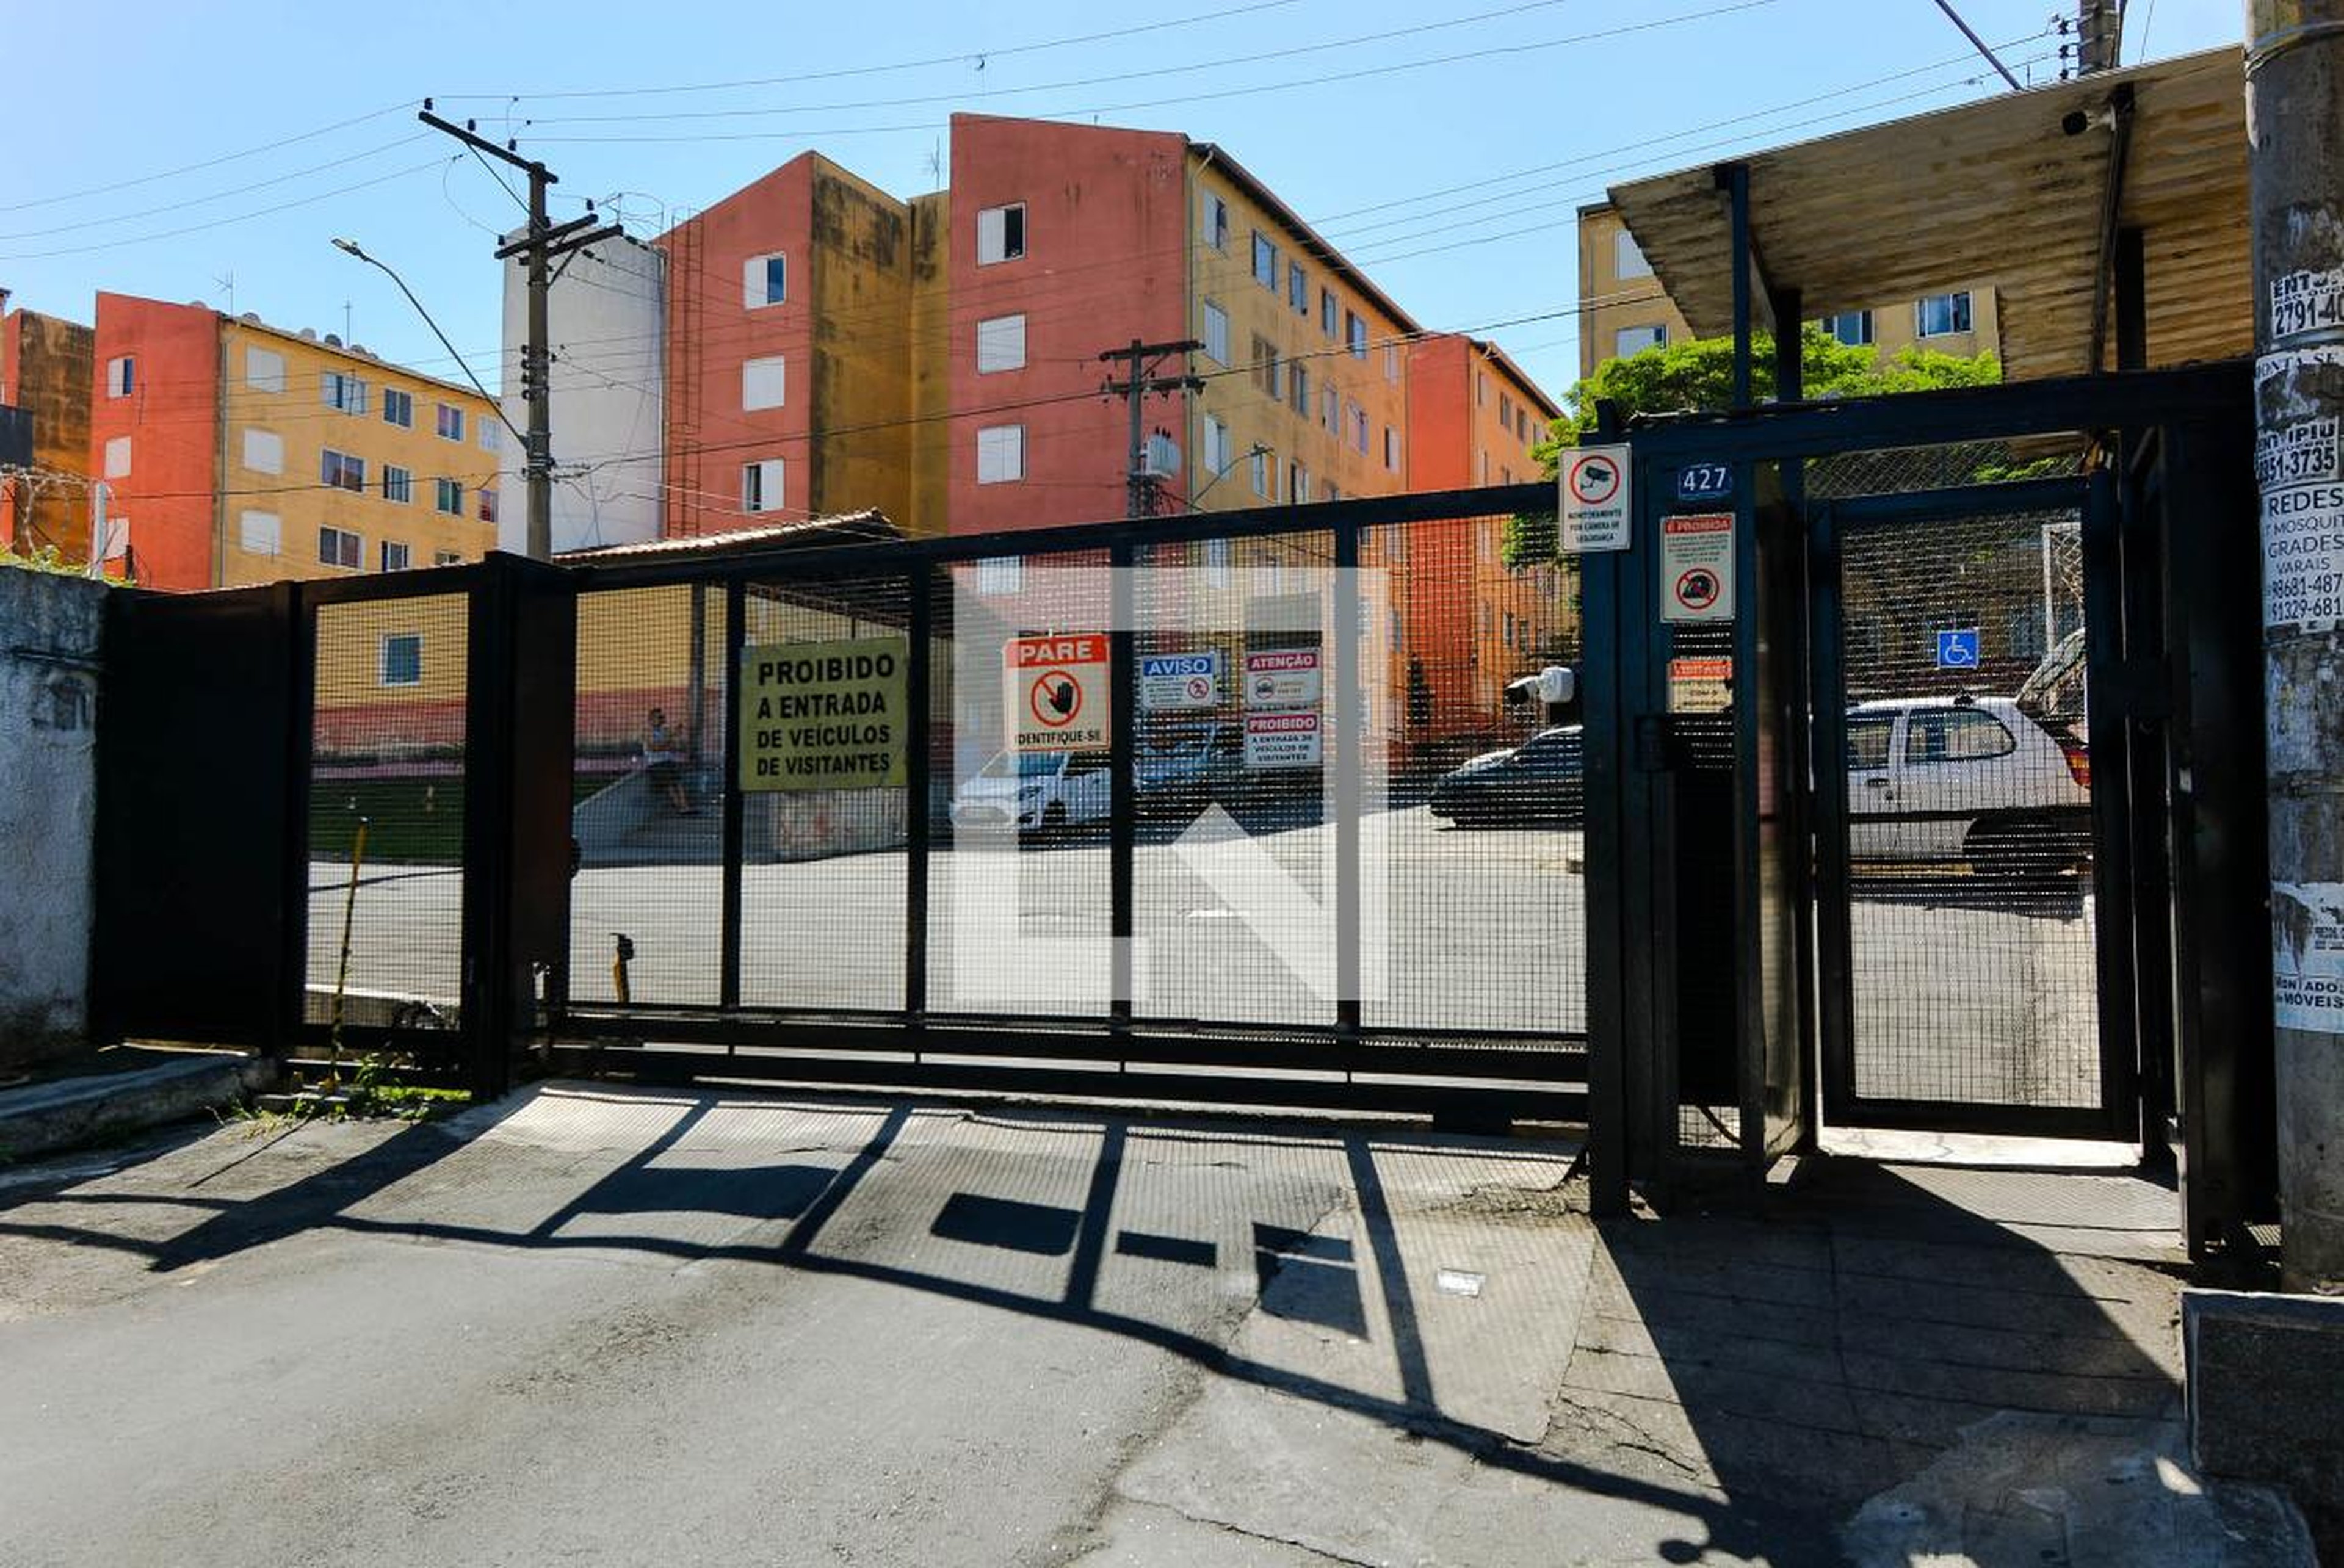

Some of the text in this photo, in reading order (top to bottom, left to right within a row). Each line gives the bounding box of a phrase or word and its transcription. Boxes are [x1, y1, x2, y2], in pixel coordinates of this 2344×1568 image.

[1684, 467, 1726, 491] 427
[2270, 488, 2343, 516] REDES
[1020, 639, 1093, 664] PARE
[1251, 653, 1314, 669] ATENÇÃO
[758, 653, 895, 686] PROIBIDO
[1148, 659, 1209, 674] AVISO
[757, 690, 888, 720] A ENTRADA
[1248, 717, 1316, 731] PROIBIDO
[757, 724, 891, 750] DE VEÍCULOS
[1015, 729, 1102, 745] IDENTIFIQUE-SE
[757, 753, 891, 776] DE VISITANTES
